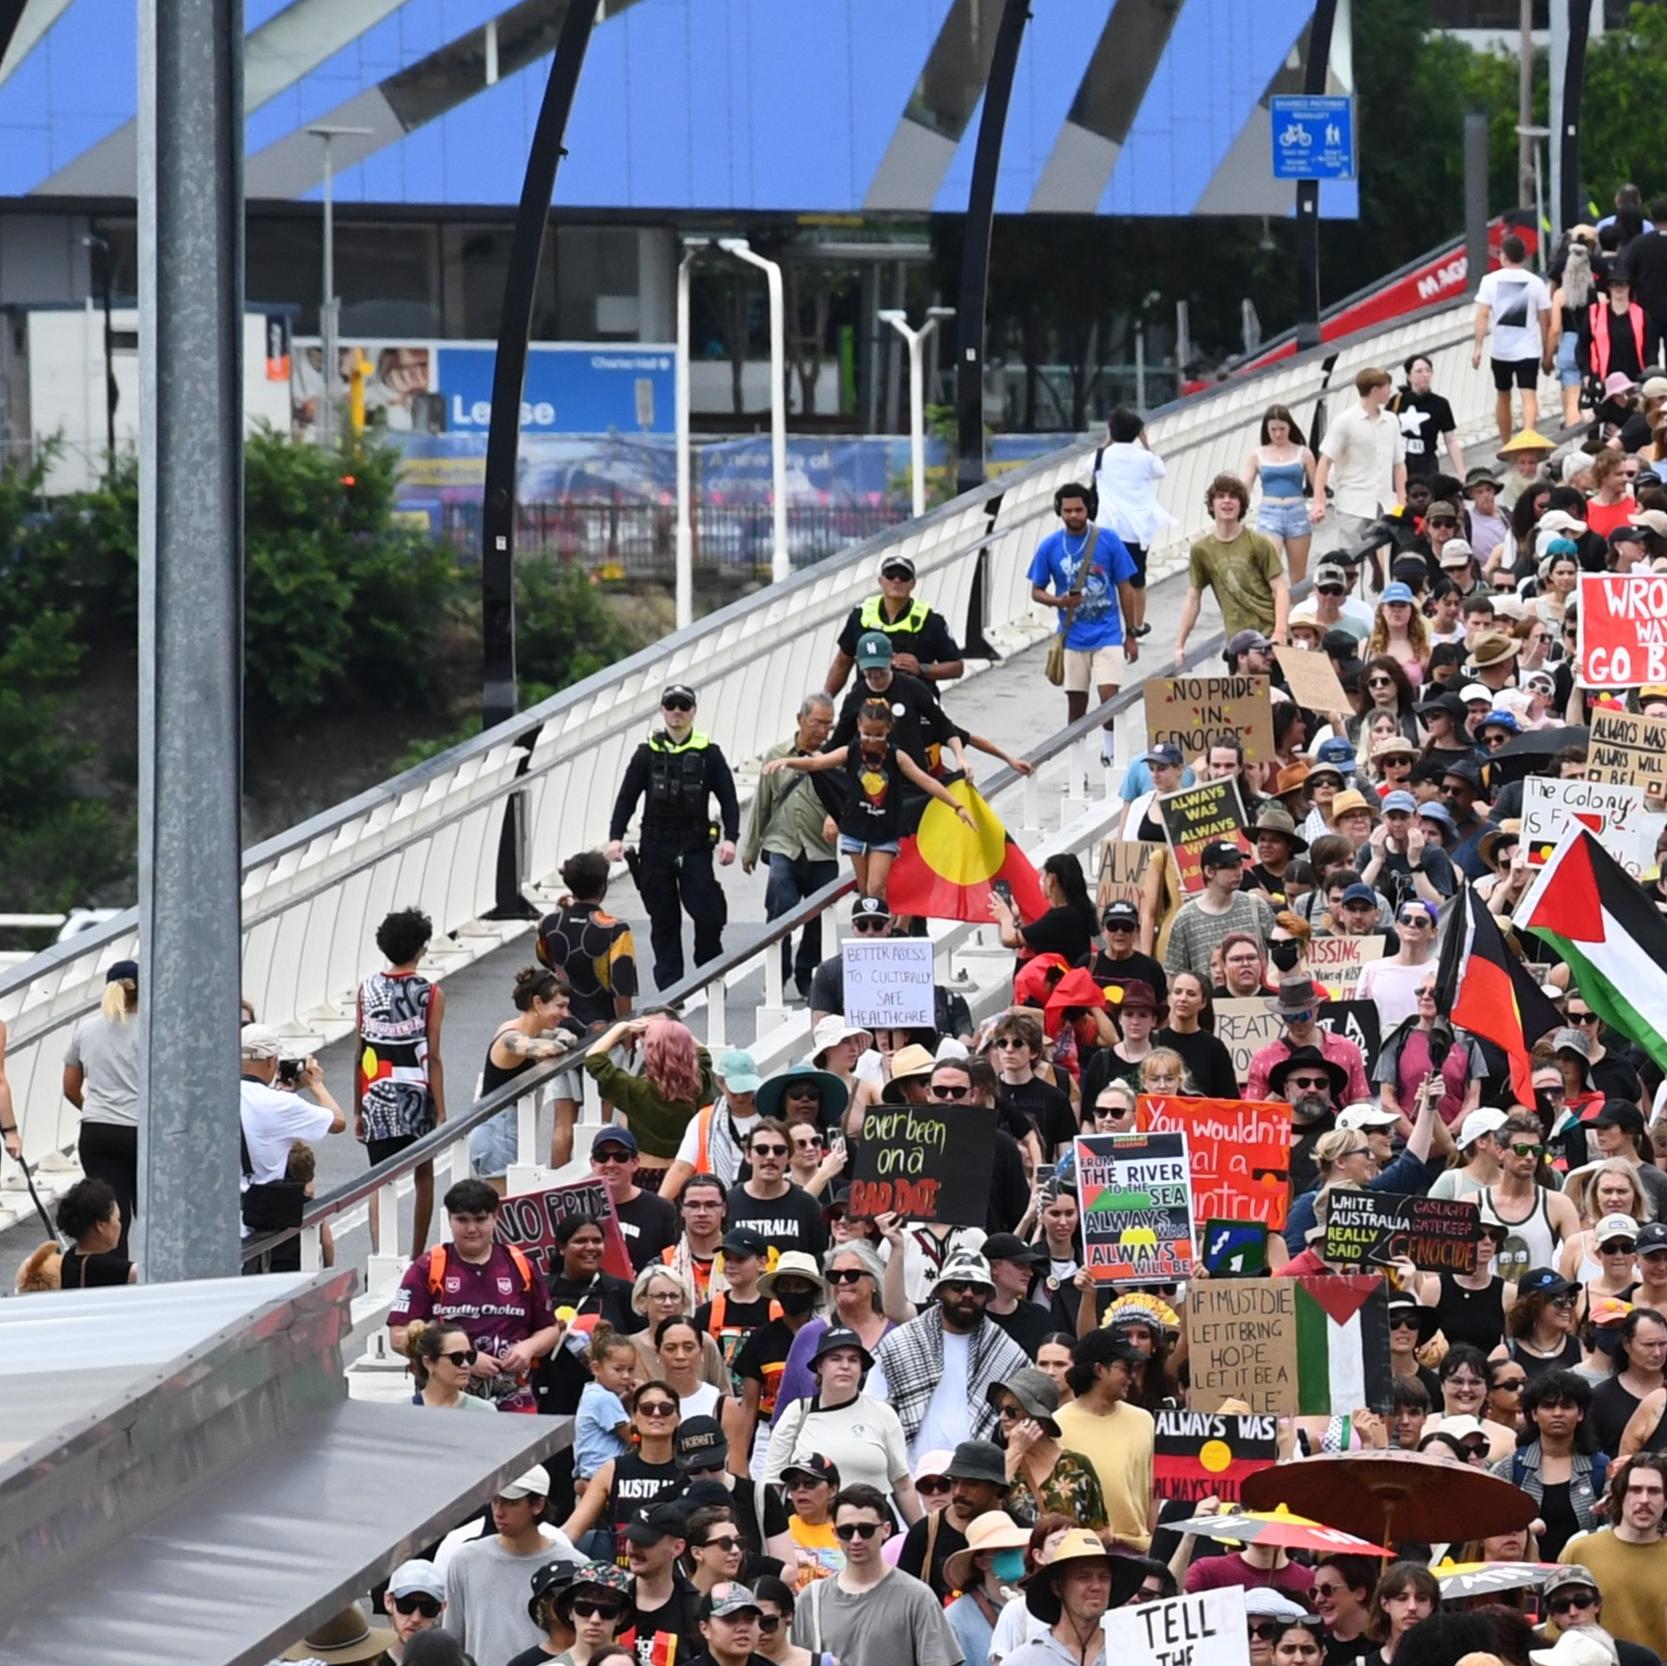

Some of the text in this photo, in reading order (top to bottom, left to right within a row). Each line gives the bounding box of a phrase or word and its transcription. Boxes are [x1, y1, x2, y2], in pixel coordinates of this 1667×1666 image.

[1588, 646, 1632, 681] GO
[1172, 678, 1256, 702] NO PRIDE
[1200, 706, 1222, 724] IN
[1592, 718, 1666, 748] ALWAYS WAS
[1592, 748, 1662, 774] ALWAYS WILL
[1170, 785, 1225, 811] ALWAYS
[1525, 778, 1556, 799] The
[1185, 803, 1217, 822] WAS
[1180, 819, 1235, 843] ALWAYS
[848, 947, 889, 963] BETTER
[871, 968, 931, 985] CULTURALLY
[877, 991, 905, 1006] SAFE
[850, 1009, 928, 1026] HEALTHCARE
[864, 1113, 907, 1142] ever
[1192, 1107, 1294, 1148] wouldn't
[1080, 1164, 1183, 1186] THE RIVER
[1148, 1186, 1186, 1207] SEA
[1332, 1195, 1375, 1213] WHITE
[1085, 1210, 1171, 1234] ALWAYS
[1330, 1212, 1411, 1231] AUSTRALIA
[1413, 1203, 1473, 1219] GASLIGHT
[1327, 1226, 1379, 1245] REALLY
[1412, 1220, 1472, 1236] GATEKEEP
[1091, 1243, 1175, 1267] ALWAYS
[1326, 1243, 1362, 1260] SAID
[1389, 1234, 1474, 1270] GENOCIDE
[1214, 1288, 1254, 1316] MUST
[1192, 1320, 1282, 1344] LET BRING
[1194, 1367, 1227, 1389] LET
[1156, 1412, 1275, 1441] ALWAYS WAS
[1136, 1600, 1217, 1648] TELL
